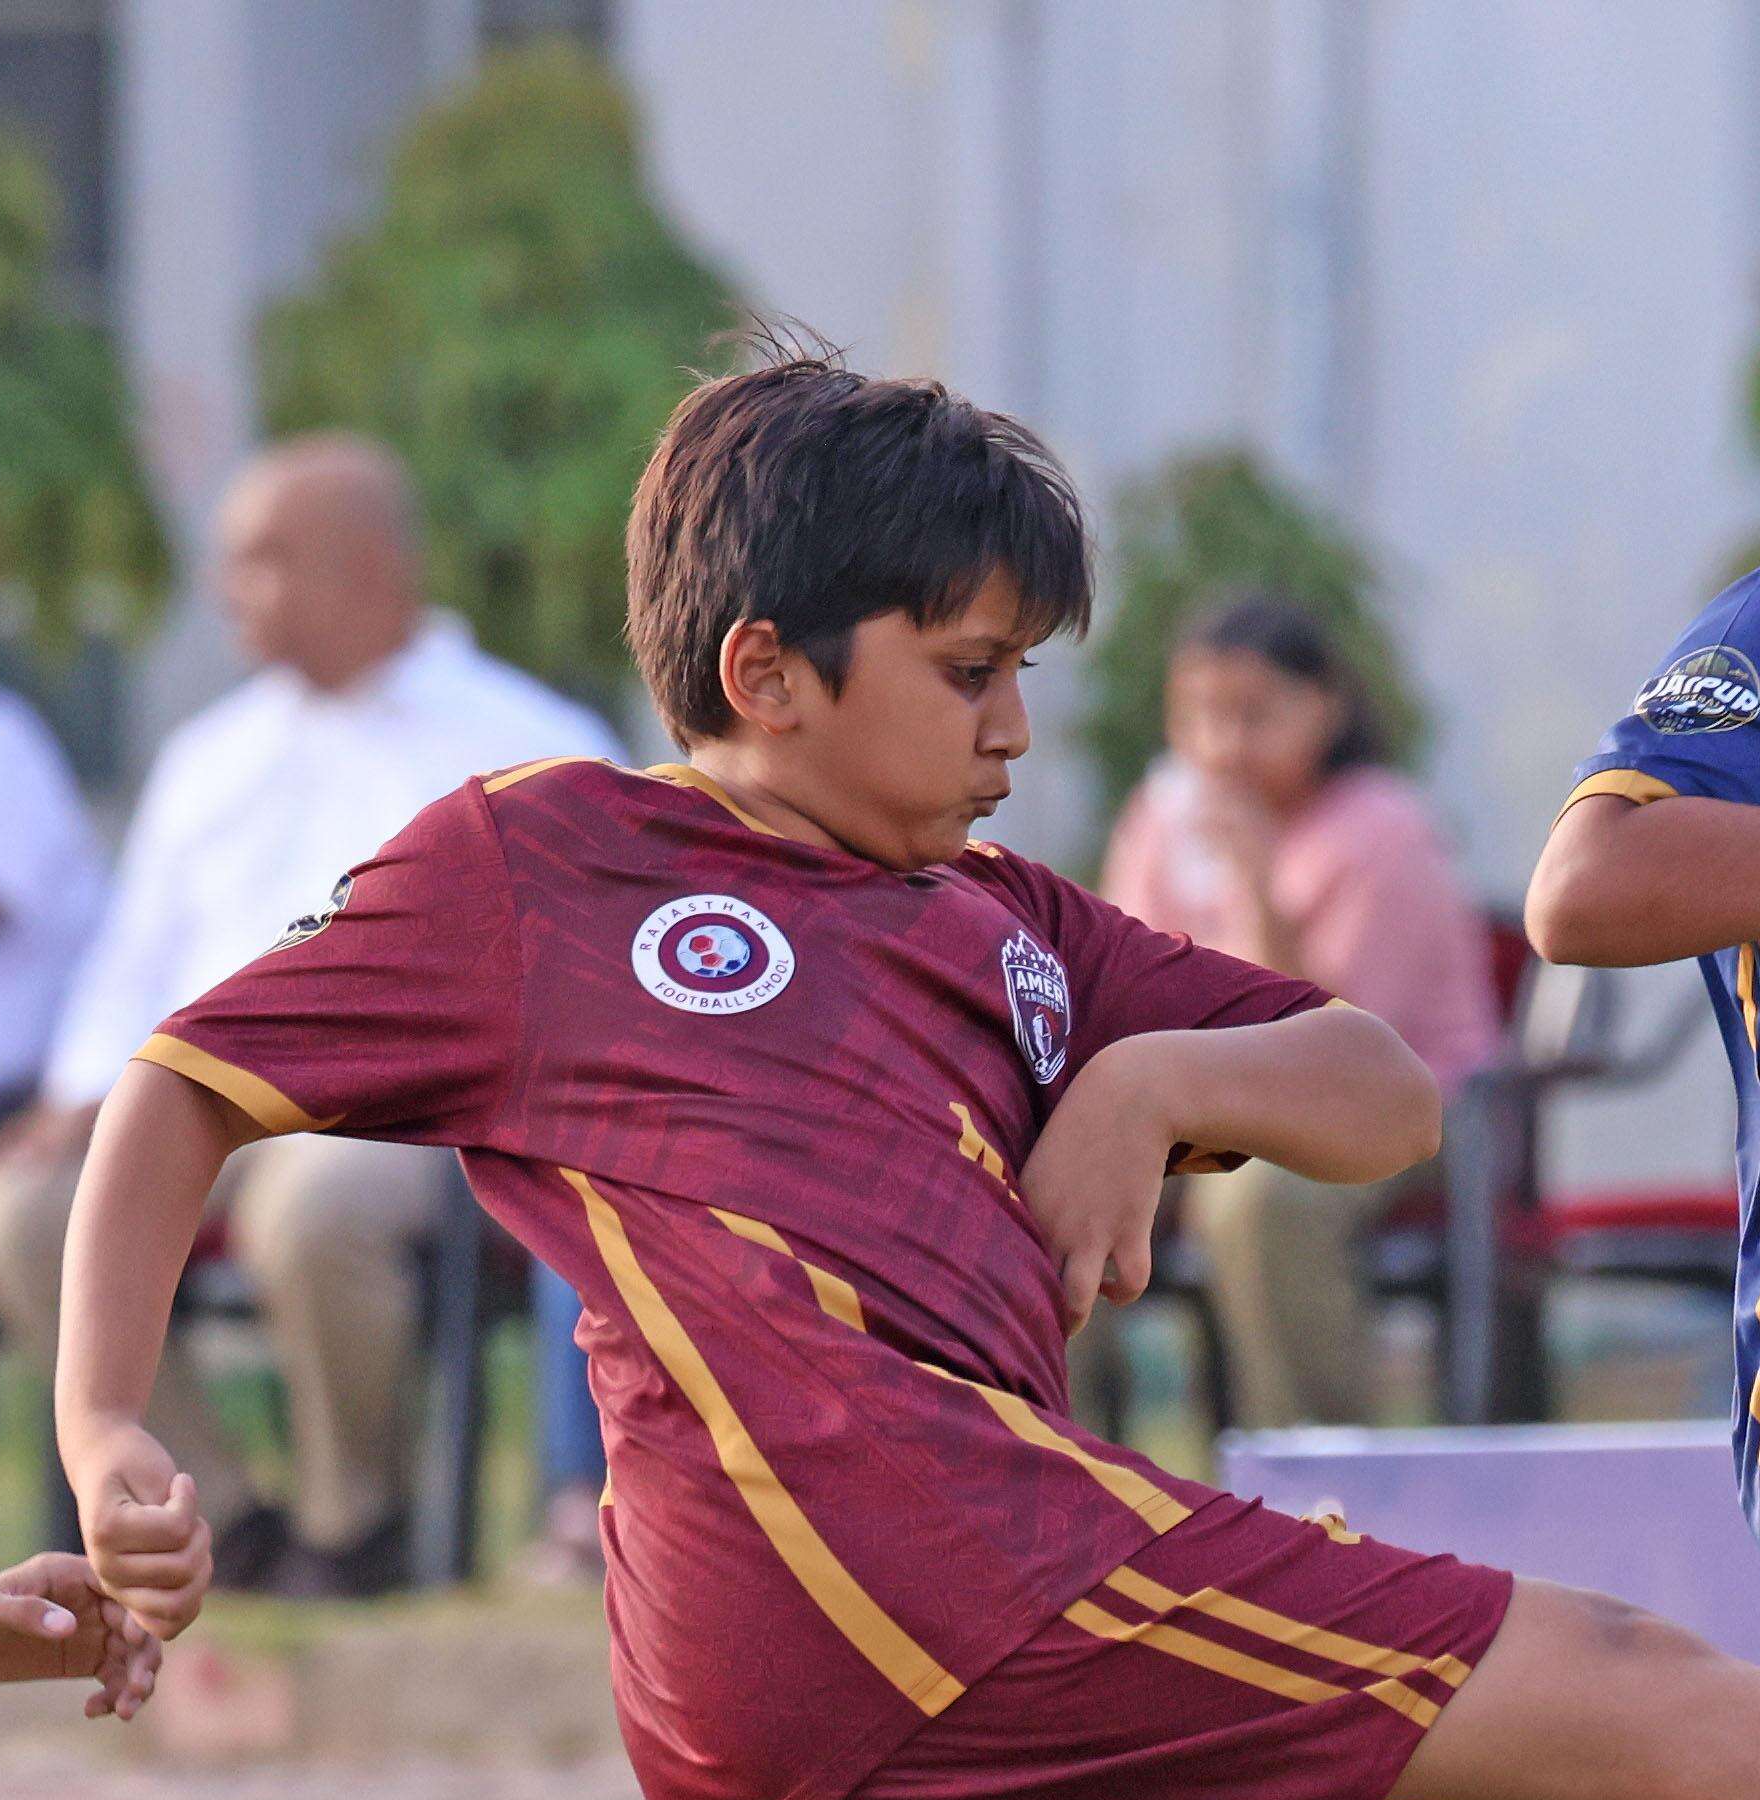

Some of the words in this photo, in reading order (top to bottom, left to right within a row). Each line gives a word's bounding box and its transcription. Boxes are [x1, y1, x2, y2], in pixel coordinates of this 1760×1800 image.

[1636, 675, 1759, 712] JAIPUR
[639, 901, 770, 951] RAJASTHAN
[654, 981, 745, 1009] FOOTBALL
[745, 959, 790, 1003] SCHOOL
[1016, 970, 1065, 1008] AMER
